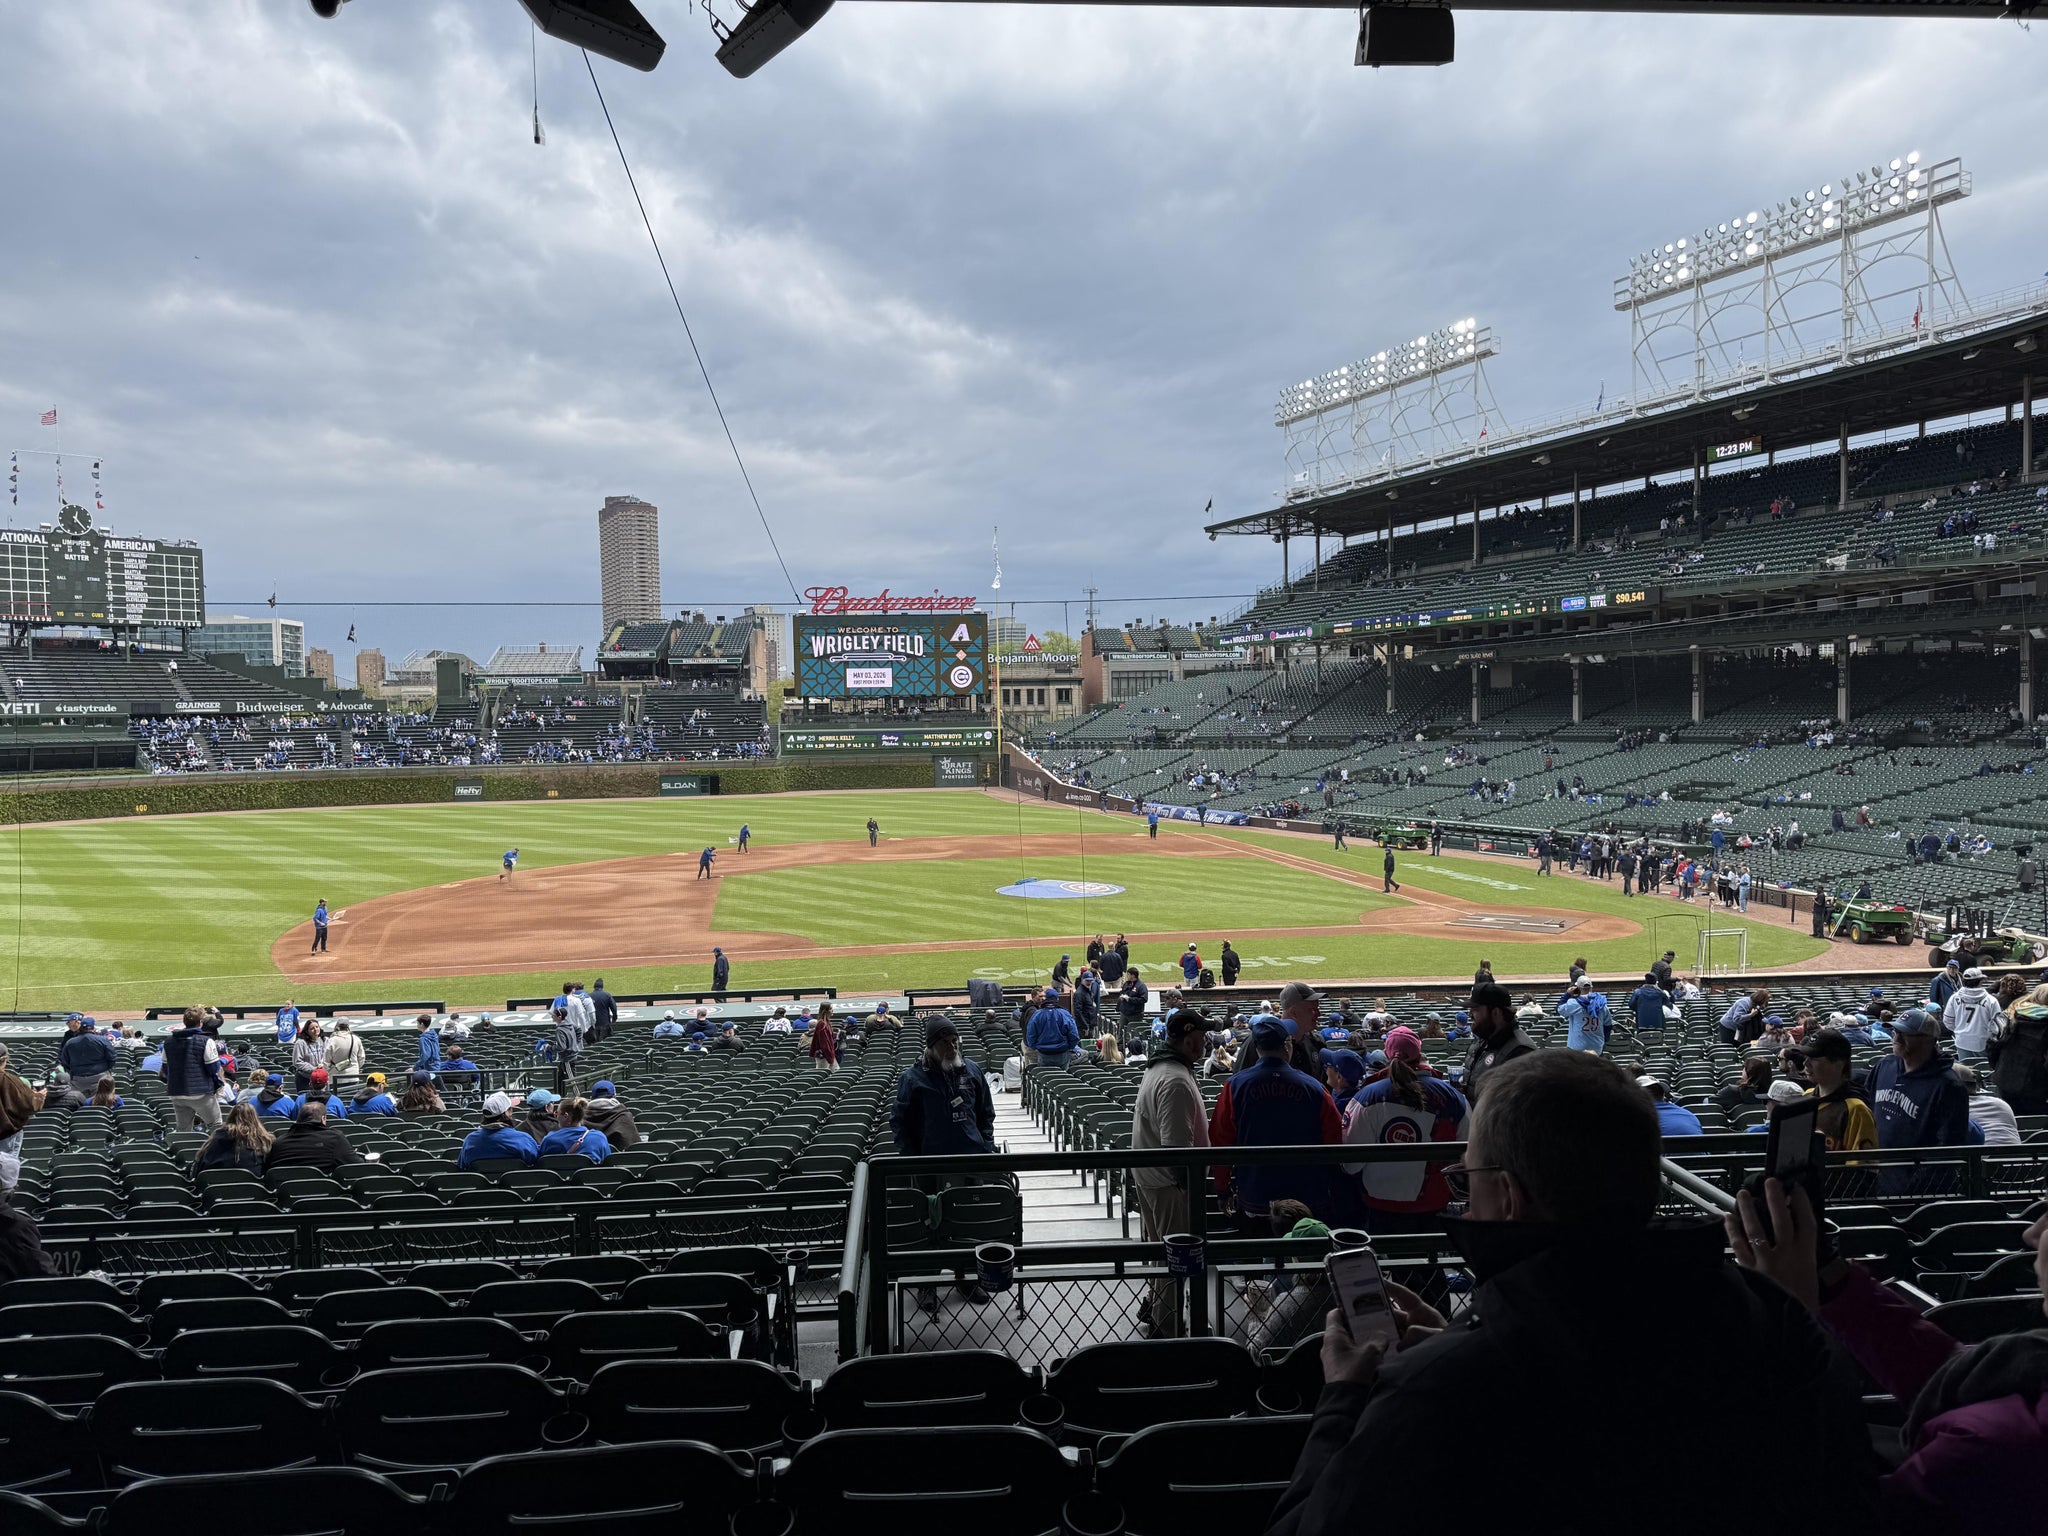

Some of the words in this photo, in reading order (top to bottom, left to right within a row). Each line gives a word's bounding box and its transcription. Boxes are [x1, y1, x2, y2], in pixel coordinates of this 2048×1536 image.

[1716, 444, 1738, 458] 12:23
[1740, 441, 1752, 452] PM
[62, 539, 91, 547] UMPIRES
[104, 540, 156, 552] AMERICAN
[804, 586, 976, 614] Budweiser
[1590, 600, 1607, 608] TOTAL
[1616, 592, 1646, 604] $90,541
[1233, 636, 1252, 644] WRIGLEY
[1252, 634, 1264, 642] FIELD
[811, 635, 880, 658] WRIGLEY
[884, 635, 924, 657] FIELD
[988, 653, 1038, 664] Benjamin
[1042, 653, 1077, 662] Moore
[0, 702, 40, 714] YETI
[62, 704, 116, 714] tastytrade
[236, 702, 304, 712] Budweiser
[330, 702, 374, 711] Advocate
[942, 762, 974, 770] DRAFT
[455, 786, 482, 796] Hefty
[1966, 1006, 1976, 1024] 7
[52, 1250, 82, 1274] 212
